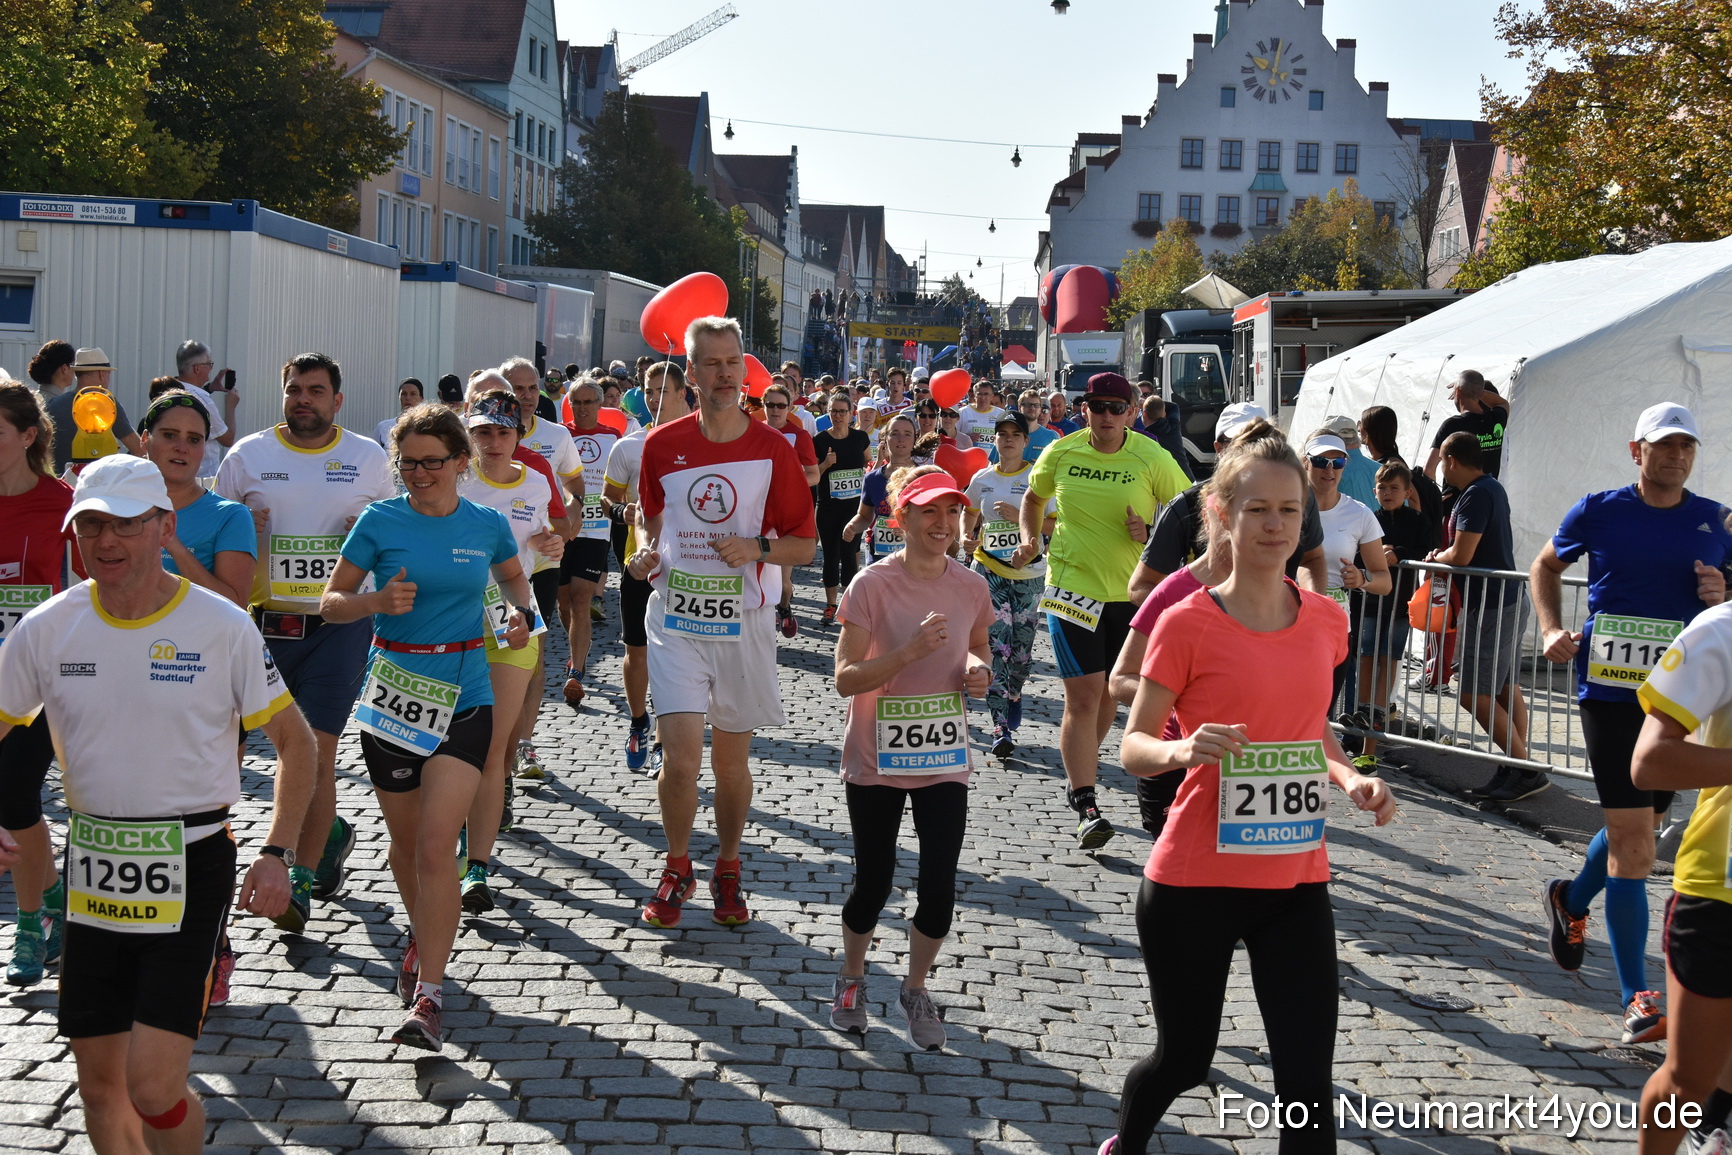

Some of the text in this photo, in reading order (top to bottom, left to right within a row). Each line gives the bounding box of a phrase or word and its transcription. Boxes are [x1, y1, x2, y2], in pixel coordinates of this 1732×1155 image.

[885, 328, 924, 337] START
[978, 435, 995, 443] 549
[1476, 433, 1492, 442] hysio
[1480, 439, 1502, 447] umarkt
[327, 462, 340, 470] 20
[1068, 465, 1121, 482] CRAFT
[834, 479, 860, 490] 2610
[512, 500, 524, 508] 20
[276, 538, 340, 553] BOCK
[672, 572, 737, 592] BOCK
[0, 588, 43, 606] CK
[1054, 586, 1098, 610] 1327
[1328, 590, 1346, 600] CK
[674, 594, 734, 619] 2456
[1045, 601, 1092, 623] CHRISTIAN
[676, 620, 728, 634] RÜDIGER
[1600, 618, 1674, 640] BOCK
[152, 645, 175, 660] 20
[1660, 648, 1682, 672] 0
[60, 664, 96, 673] BOCK
[151, 662, 206, 672] Neumarkter
[1600, 668, 1646, 680] ANDRE
[150, 673, 195, 684] Stadtlauf
[377, 660, 449, 704] BOCK
[372, 684, 439, 729] 2481
[884, 696, 957, 717] BOCK
[378, 718, 418, 742] IRENE
[888, 721, 957, 748] 2649
[891, 753, 956, 766] STEFANIE
[1230, 746, 1322, 772] BOCK
[1235, 780, 1320, 816] 2186
[77, 820, 174, 851] BOCK
[1240, 825, 1313, 842] CAROLIN
[80, 856, 170, 894] 1296
[87, 899, 158, 919] HARALD
